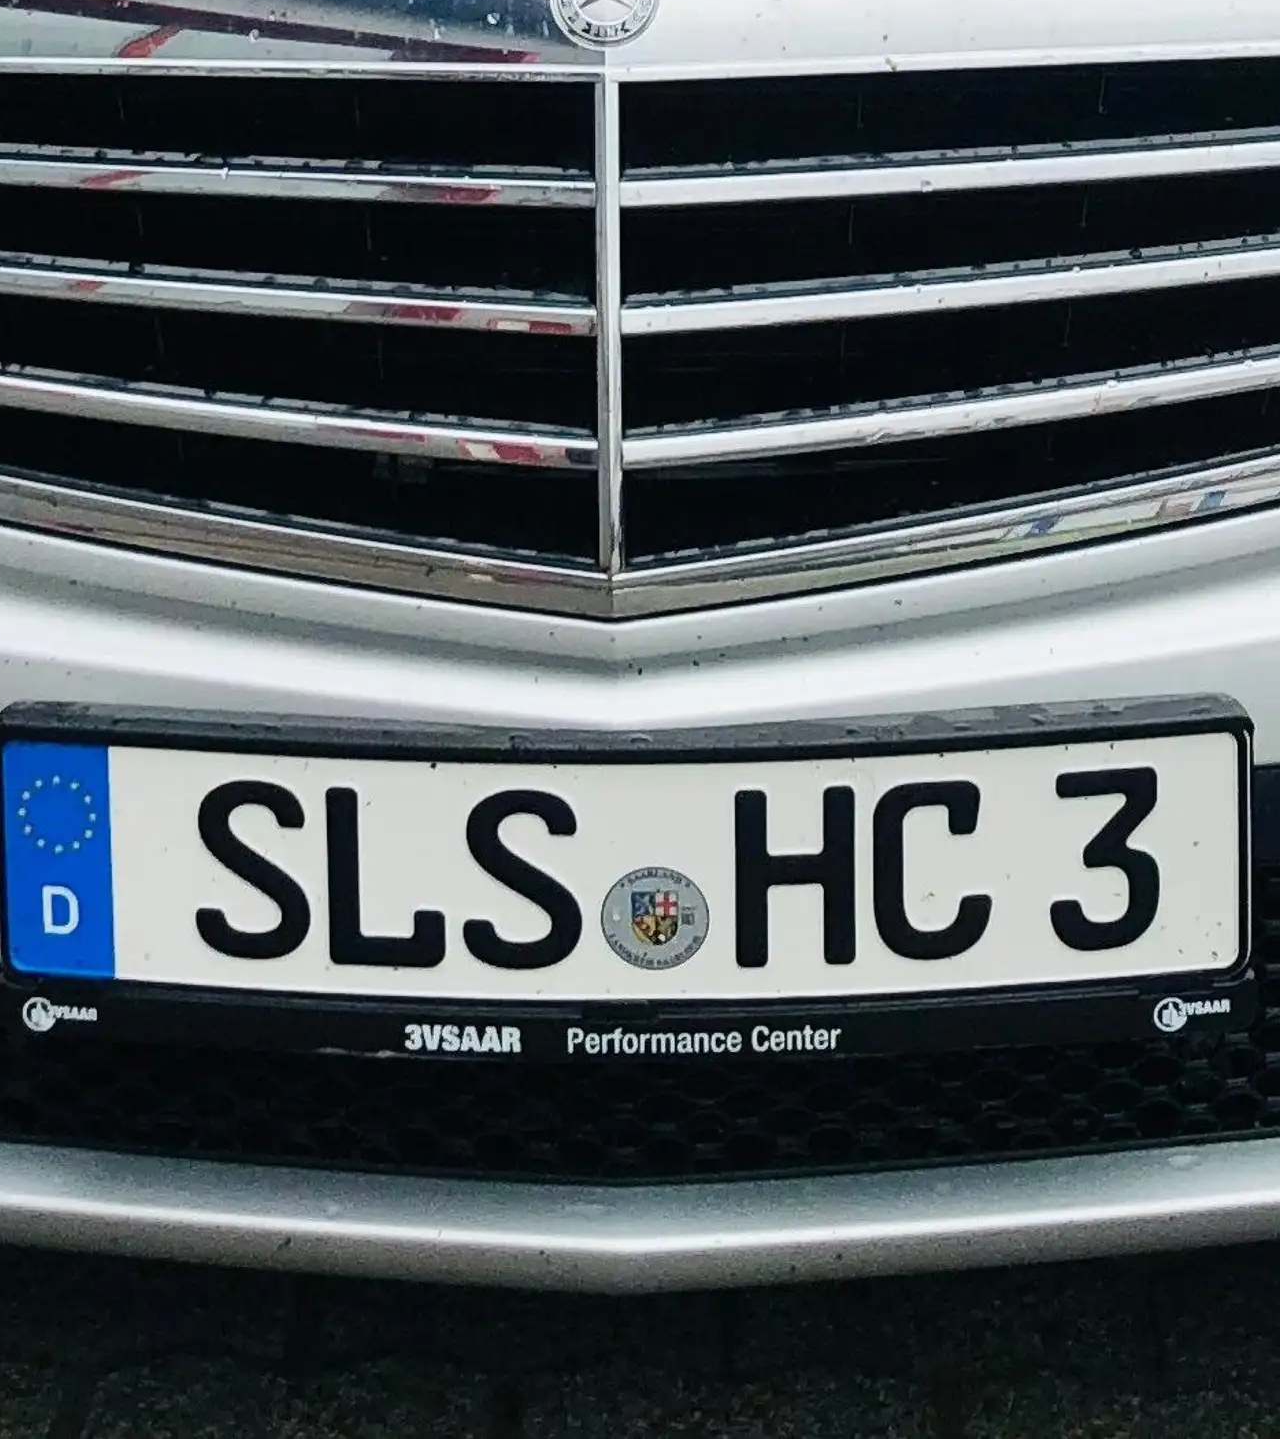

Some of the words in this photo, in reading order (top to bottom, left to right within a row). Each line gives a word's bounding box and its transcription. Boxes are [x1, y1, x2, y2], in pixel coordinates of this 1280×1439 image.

[194, 779, 584, 970] SLS
[733, 780, 993, 969] HC
[1049, 766, 1162, 952] 3
[41, 884, 81, 936] D
[403, 1024, 522, 1054] 3VSAAR
[566, 1025, 742, 1055] Performance
[750, 1024, 842, 1053] Center
